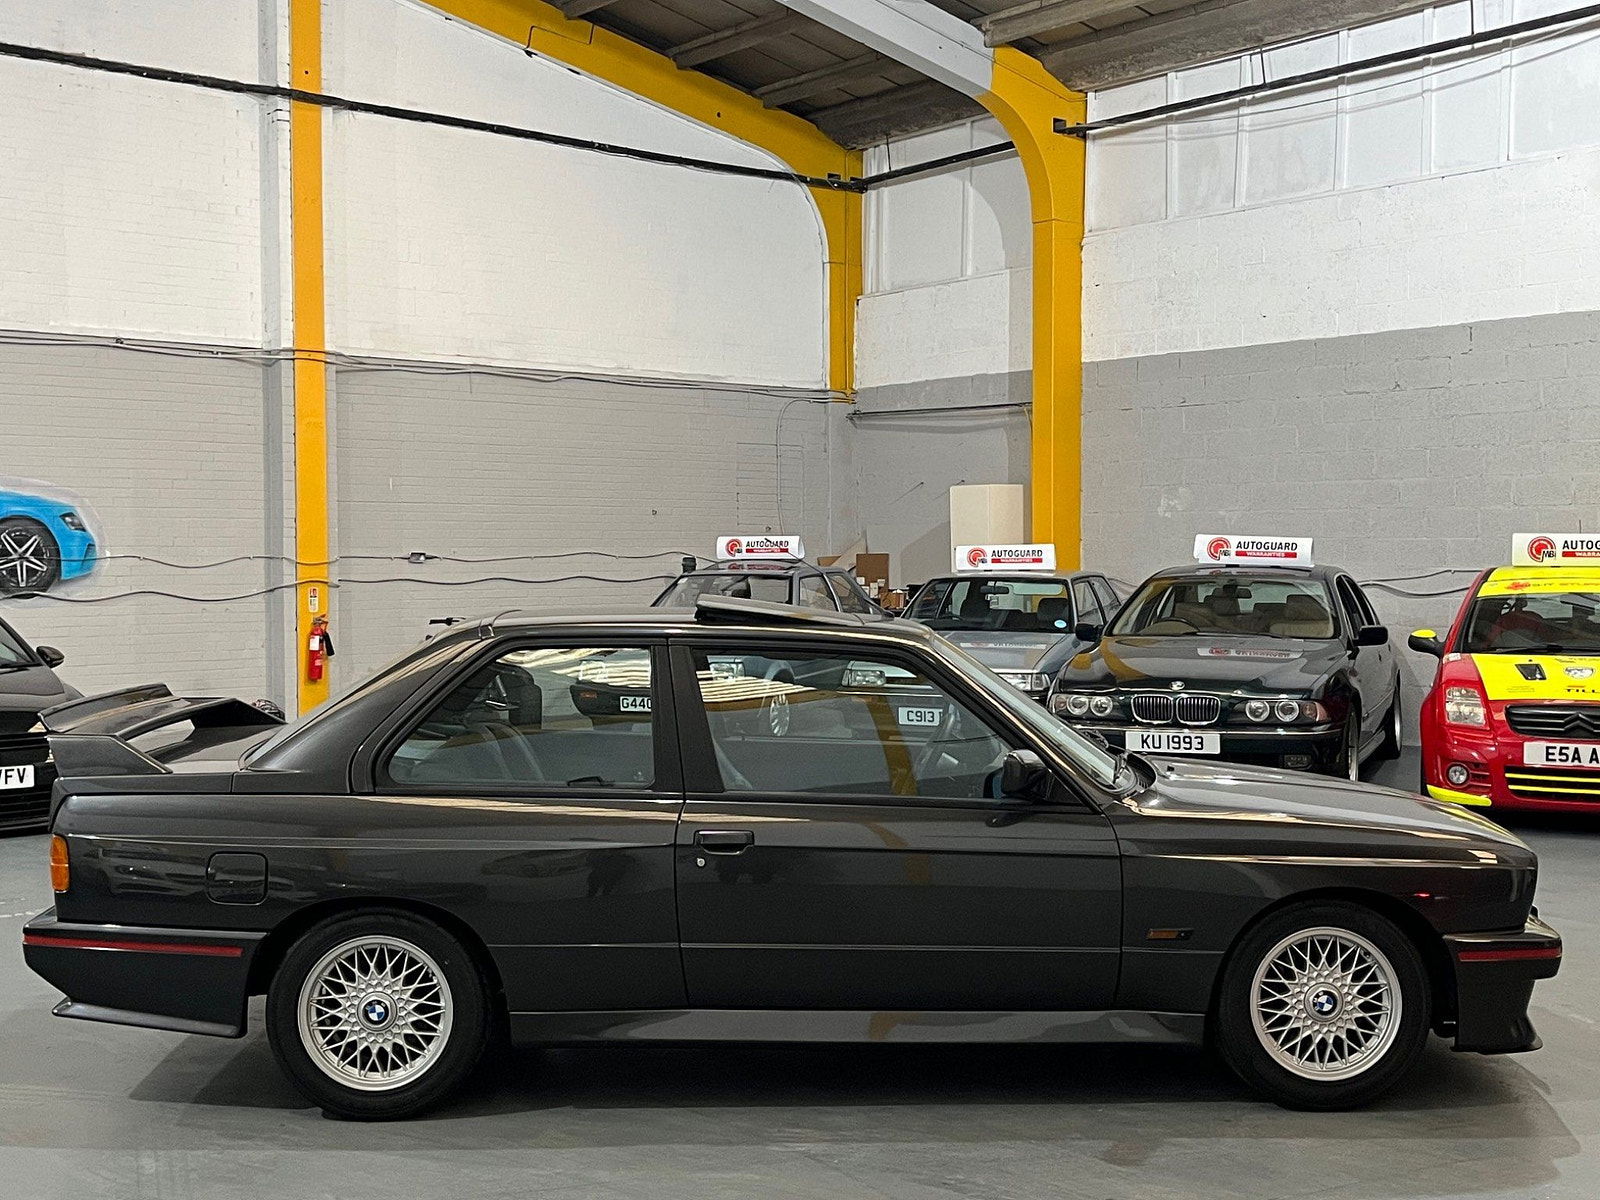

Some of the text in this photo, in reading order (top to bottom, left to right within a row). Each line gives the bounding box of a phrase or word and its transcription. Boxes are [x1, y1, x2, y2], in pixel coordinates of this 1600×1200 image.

[745, 540, 789, 548] AUTOGUARD
[1236, 541, 1298, 551] AUTOGUARD
[991, 549, 1043, 557] AUTOGUARD
[906, 710, 935, 722] C913
[1141, 734, 1204, 750] KU 1993
[1545, 746, 1582, 763] E5A
